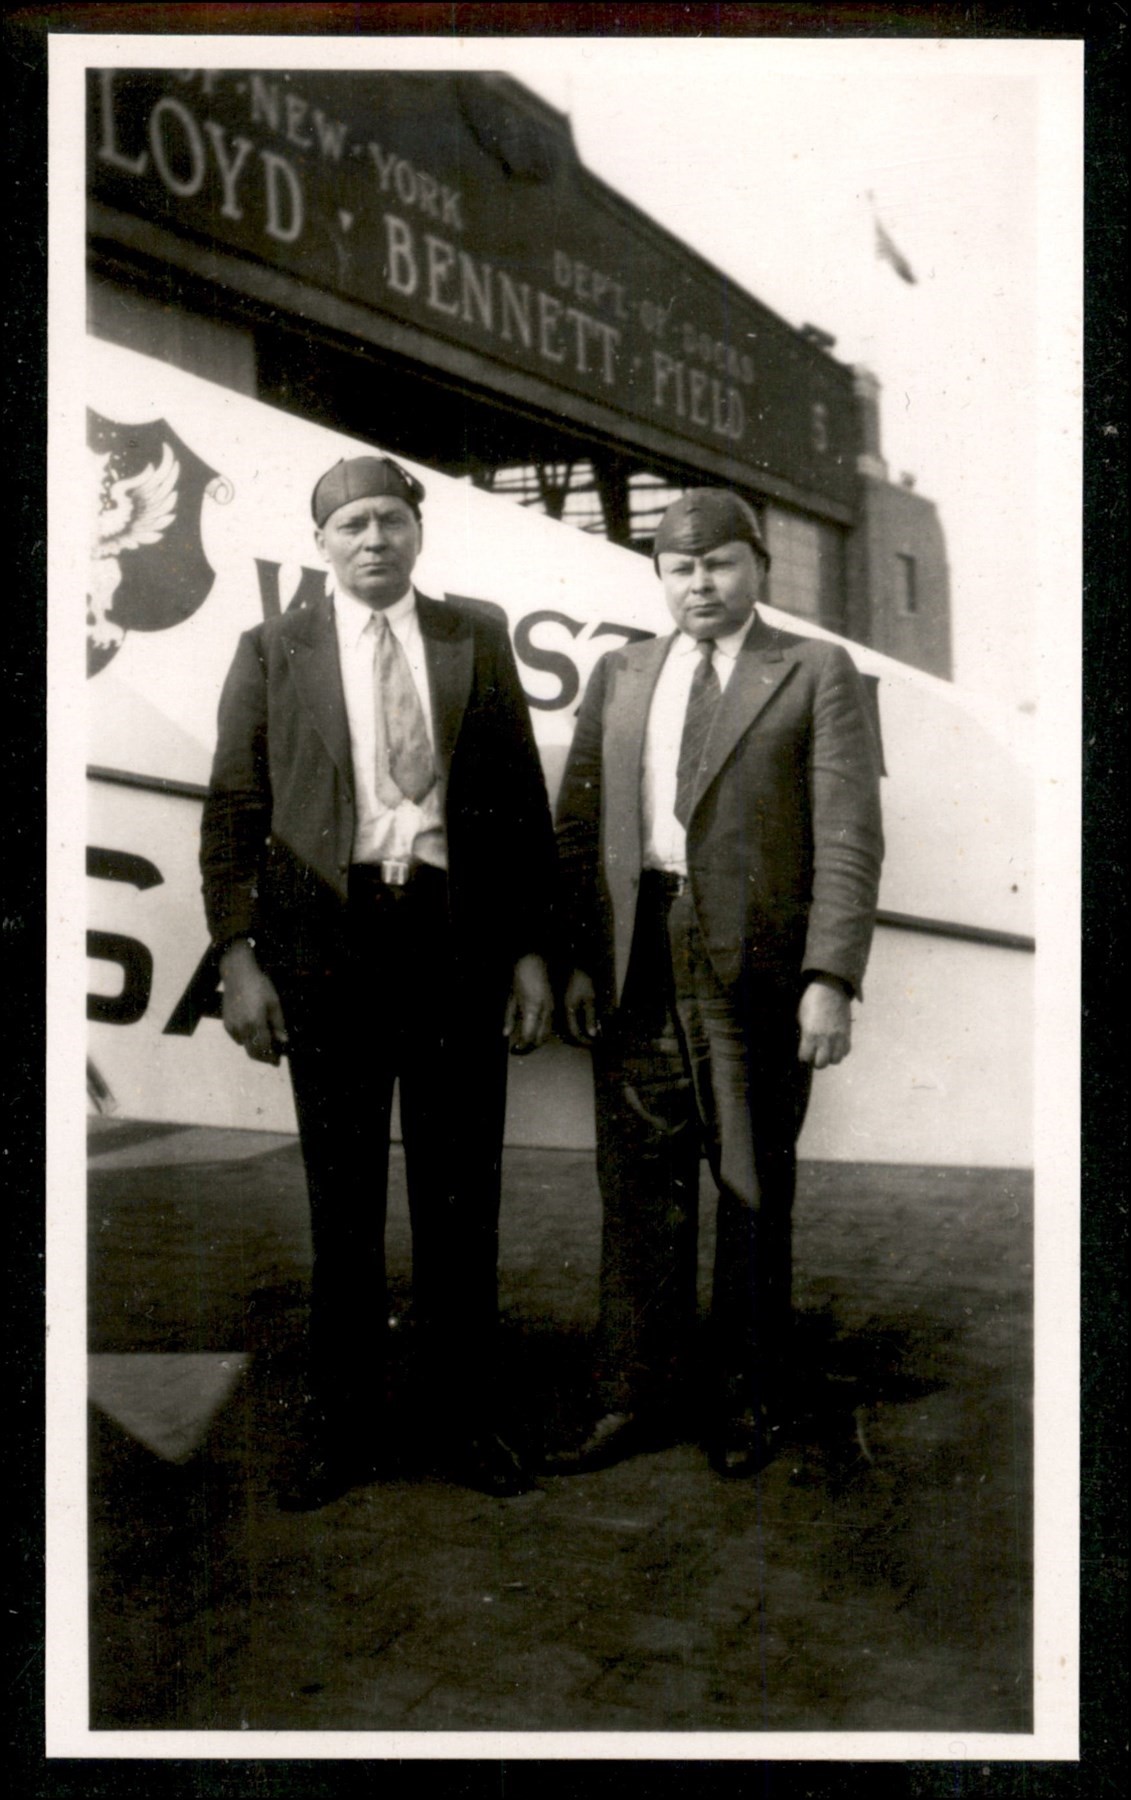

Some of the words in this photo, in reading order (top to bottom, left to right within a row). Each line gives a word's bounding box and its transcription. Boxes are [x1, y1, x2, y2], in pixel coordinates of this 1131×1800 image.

[250, 74, 347, 160] NEW
[368, 142, 462, 230] YORK
[383, 214, 621, 384] BENNETT
[652, 350, 744, 440] FIELD
